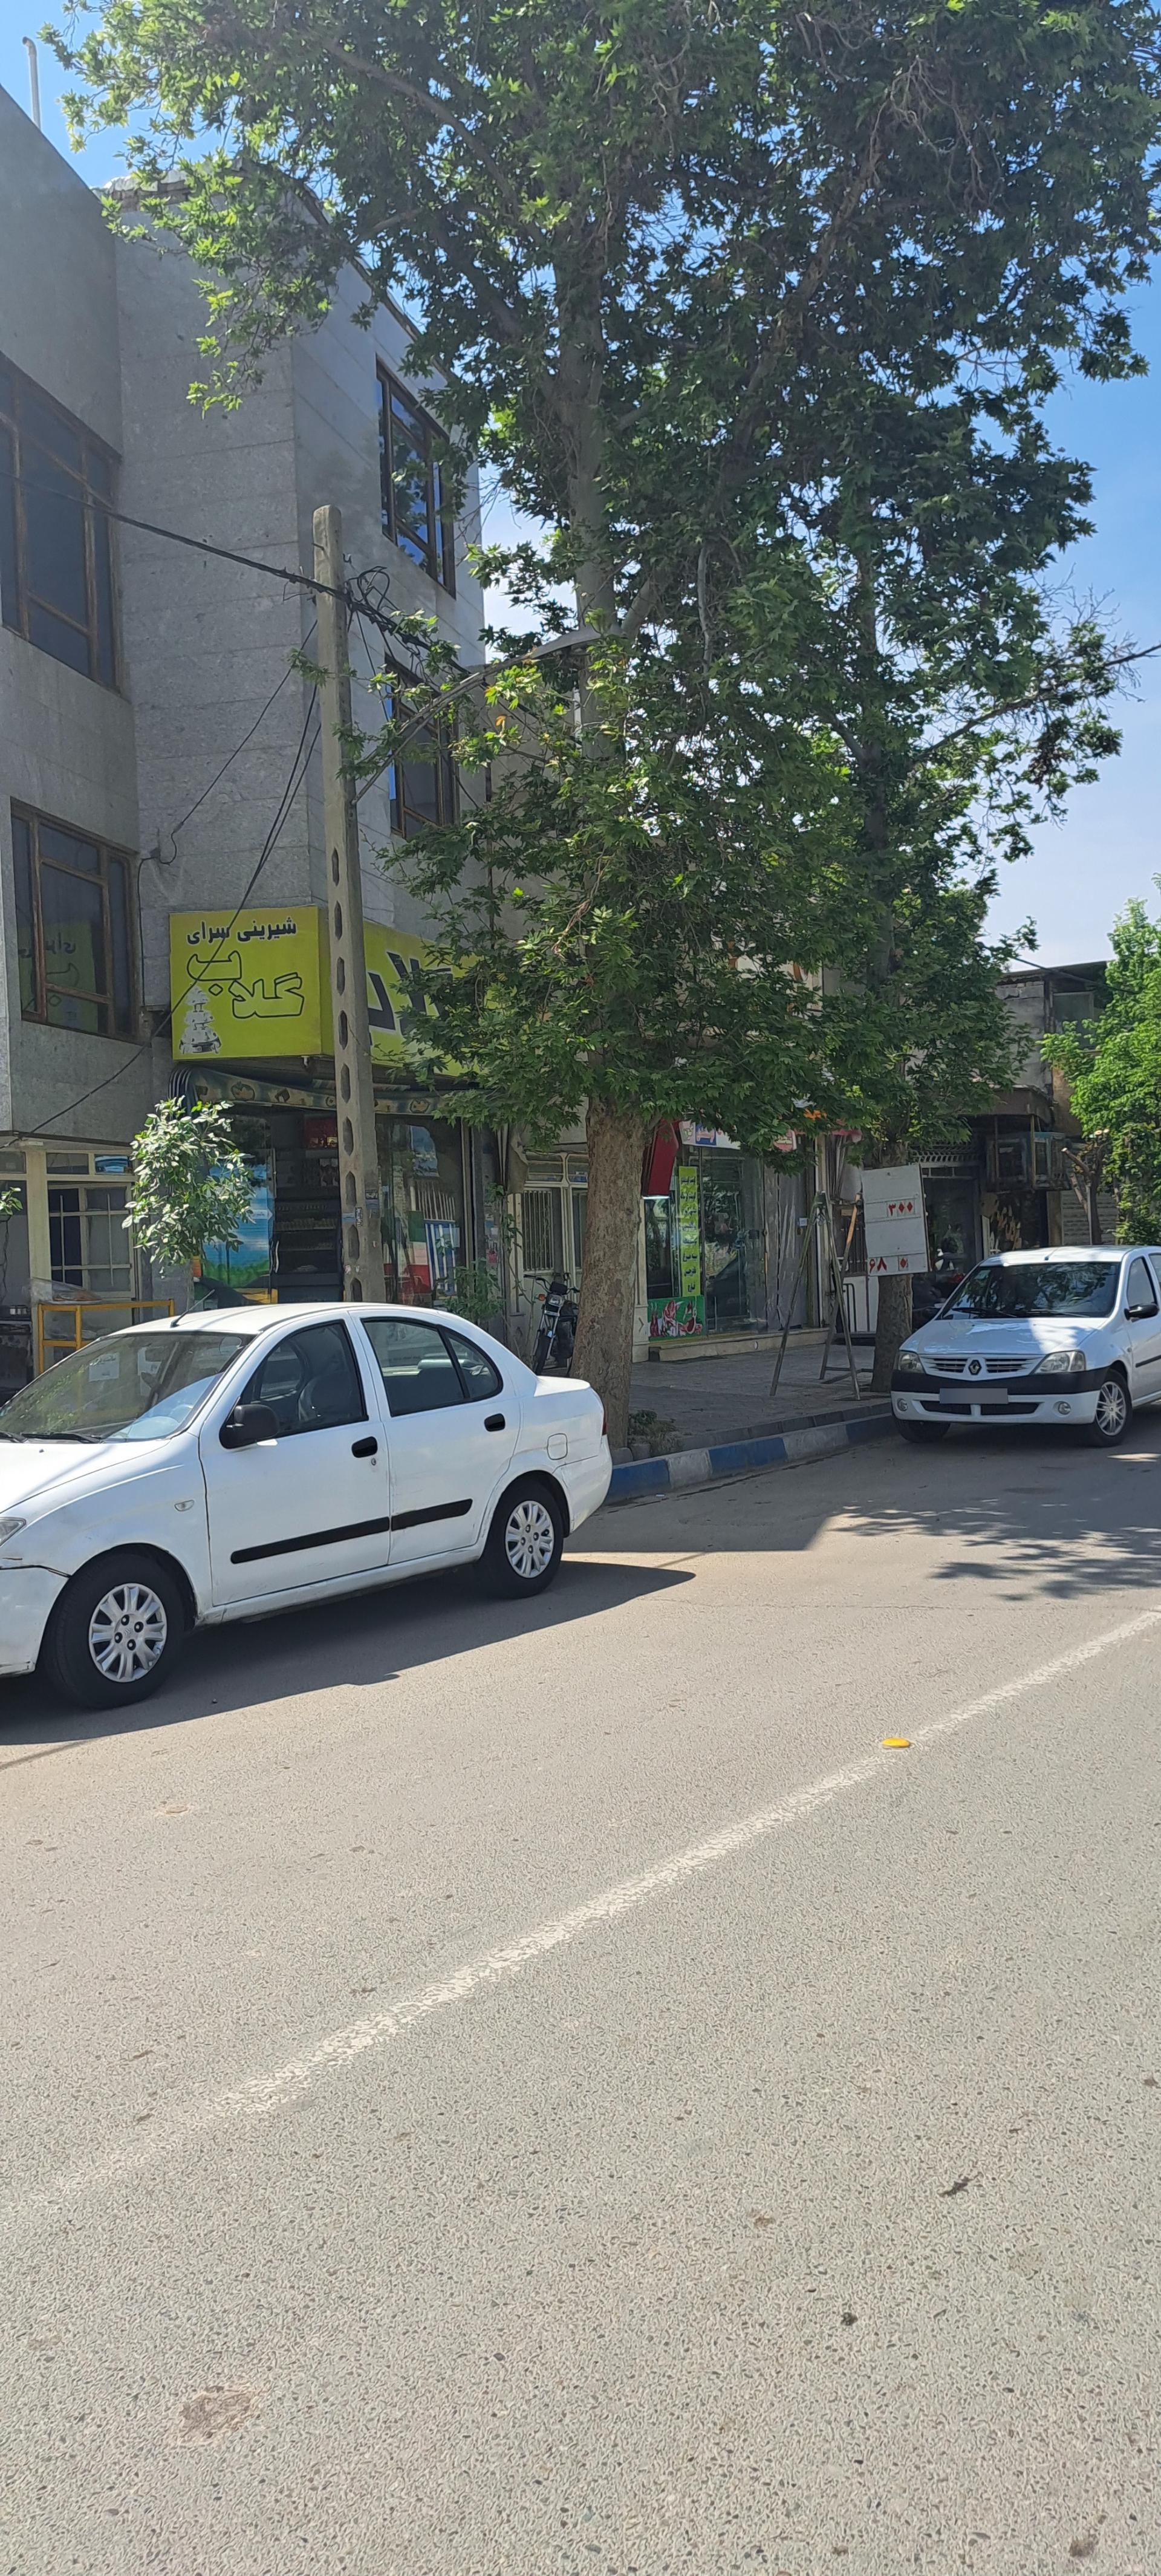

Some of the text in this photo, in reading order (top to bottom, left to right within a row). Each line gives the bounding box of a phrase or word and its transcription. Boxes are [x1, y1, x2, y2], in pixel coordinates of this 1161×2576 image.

[187, 917, 296, 945] شیرینی سرای
[186, 950, 305, 1019] گلاب
